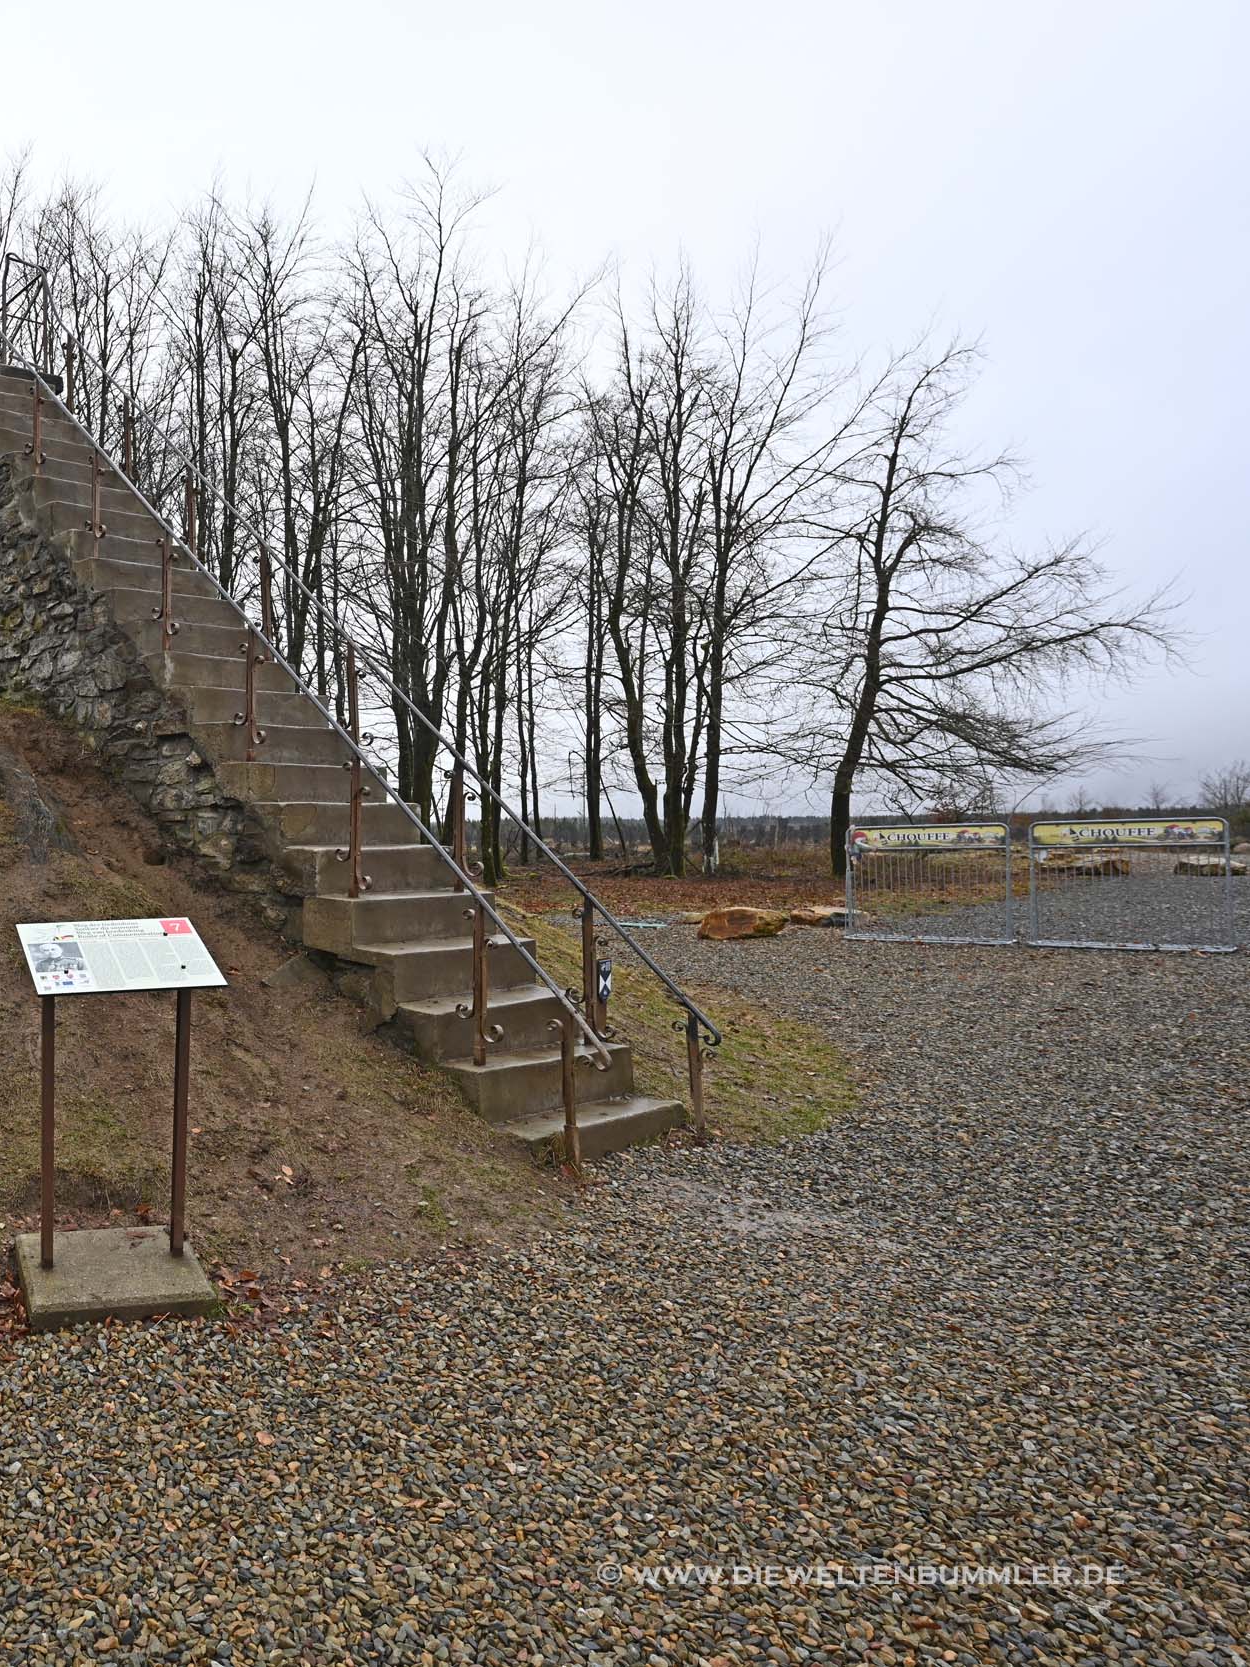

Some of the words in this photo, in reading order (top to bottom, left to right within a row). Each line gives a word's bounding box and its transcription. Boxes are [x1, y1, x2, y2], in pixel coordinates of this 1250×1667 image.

[887, 832, 950, 841] CHOUFFE
[1078, 827, 1156, 837] CHOUFFE
[169, 923, 180, 931] 7
